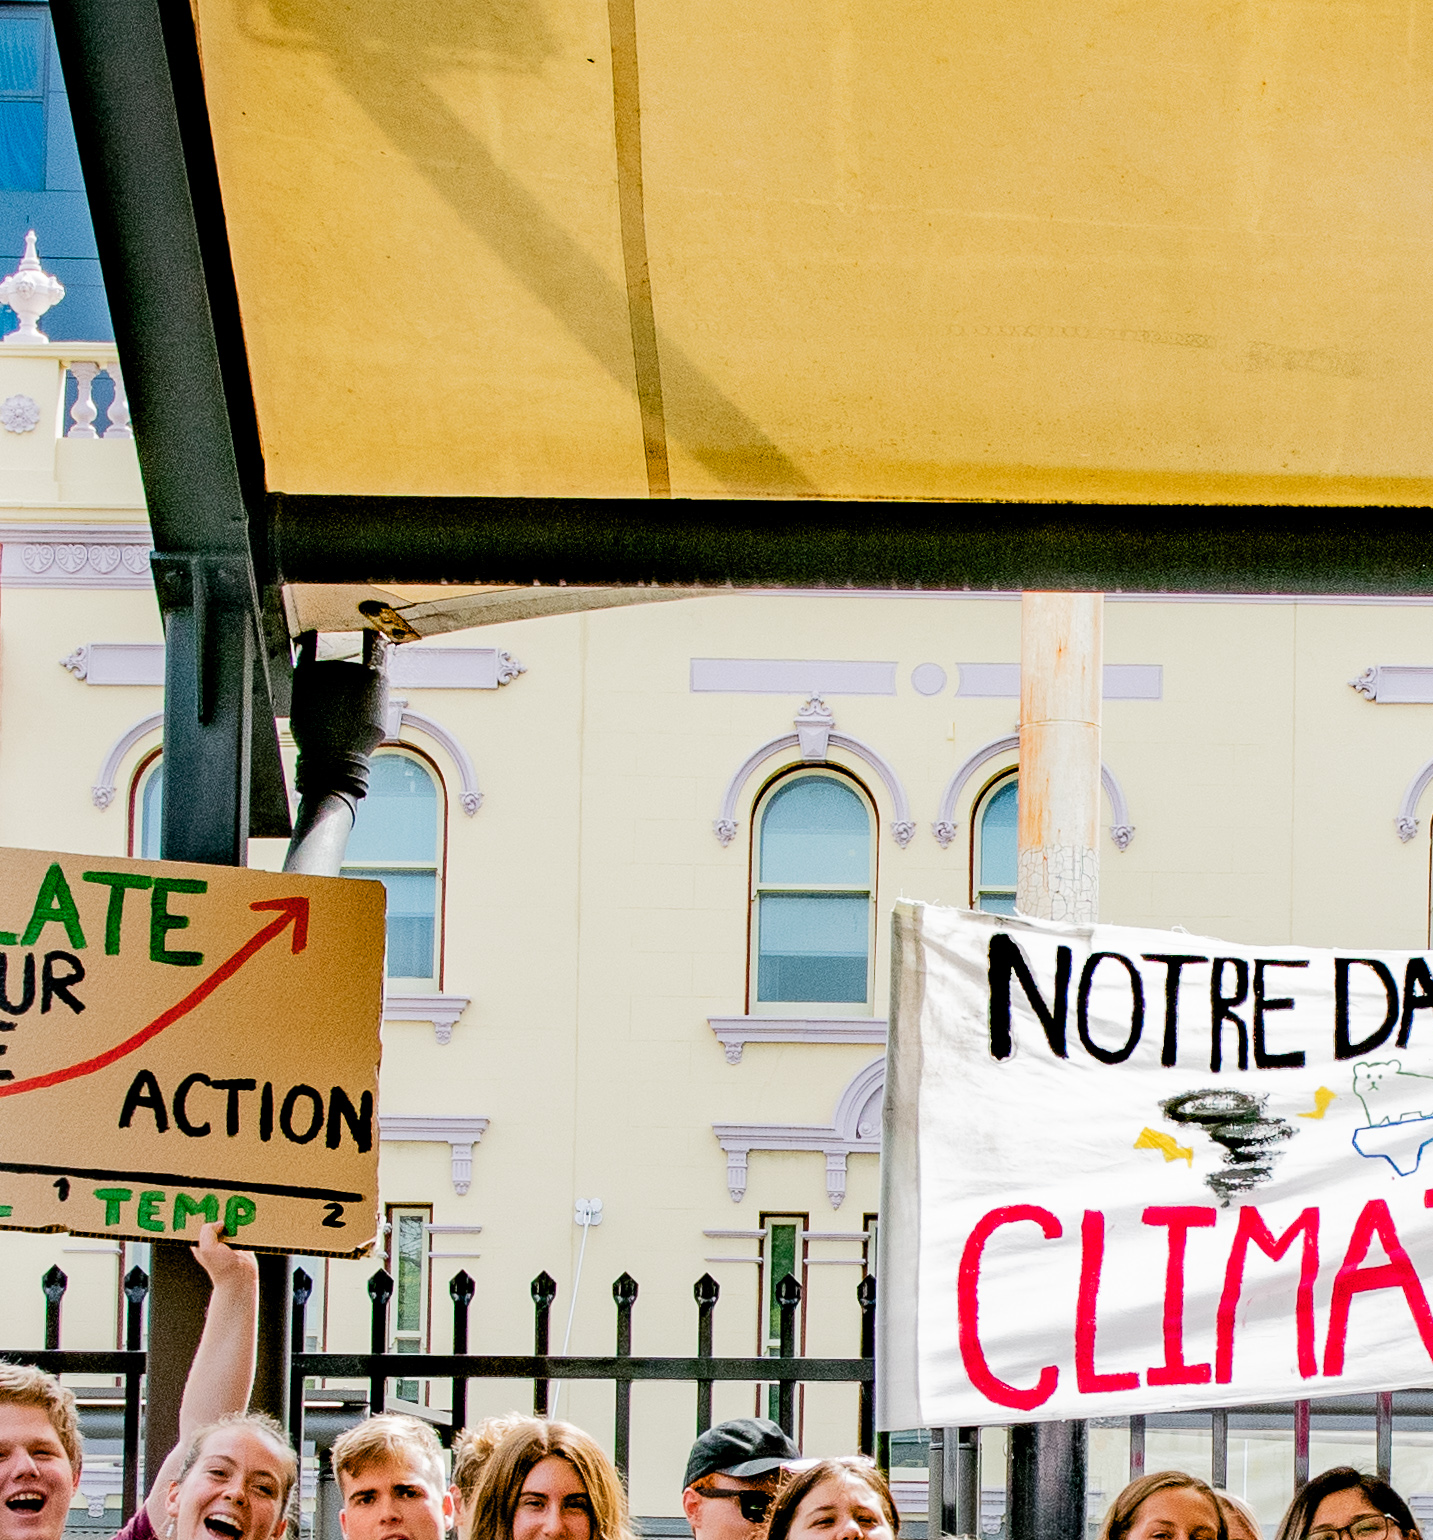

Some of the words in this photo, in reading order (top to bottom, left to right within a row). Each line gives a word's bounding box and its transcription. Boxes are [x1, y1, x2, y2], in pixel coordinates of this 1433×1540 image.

[988, 932, 1309, 1071] NOTRE
[118, 1070, 372, 1153] ACTION
[94, 1187, 257, 1237] TEMP
[322, 1203, 346, 1228] 2
